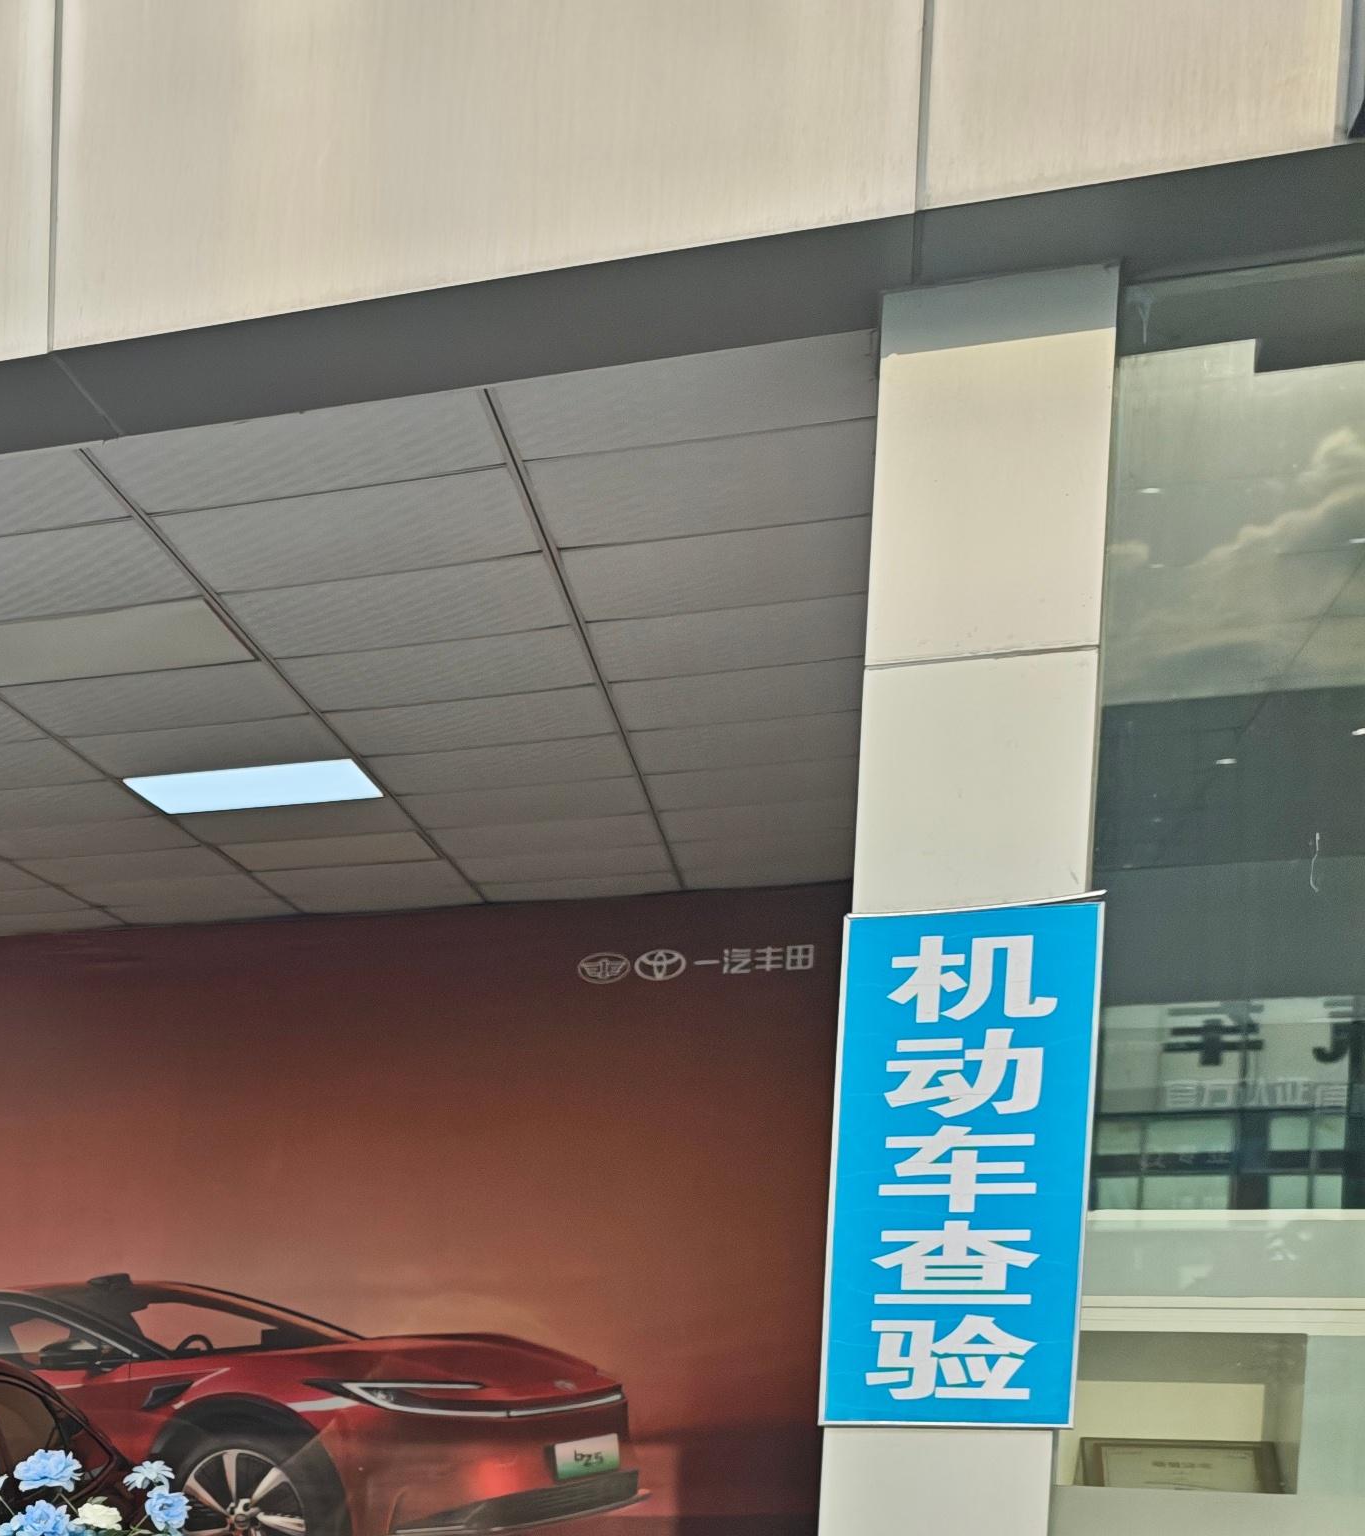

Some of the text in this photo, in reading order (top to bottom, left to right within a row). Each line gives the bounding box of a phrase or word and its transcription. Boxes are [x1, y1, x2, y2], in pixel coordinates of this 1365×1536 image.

[693, 944, 815, 975] 一汽丰田
[865, 934, 1058, 1401] 机动车查验
